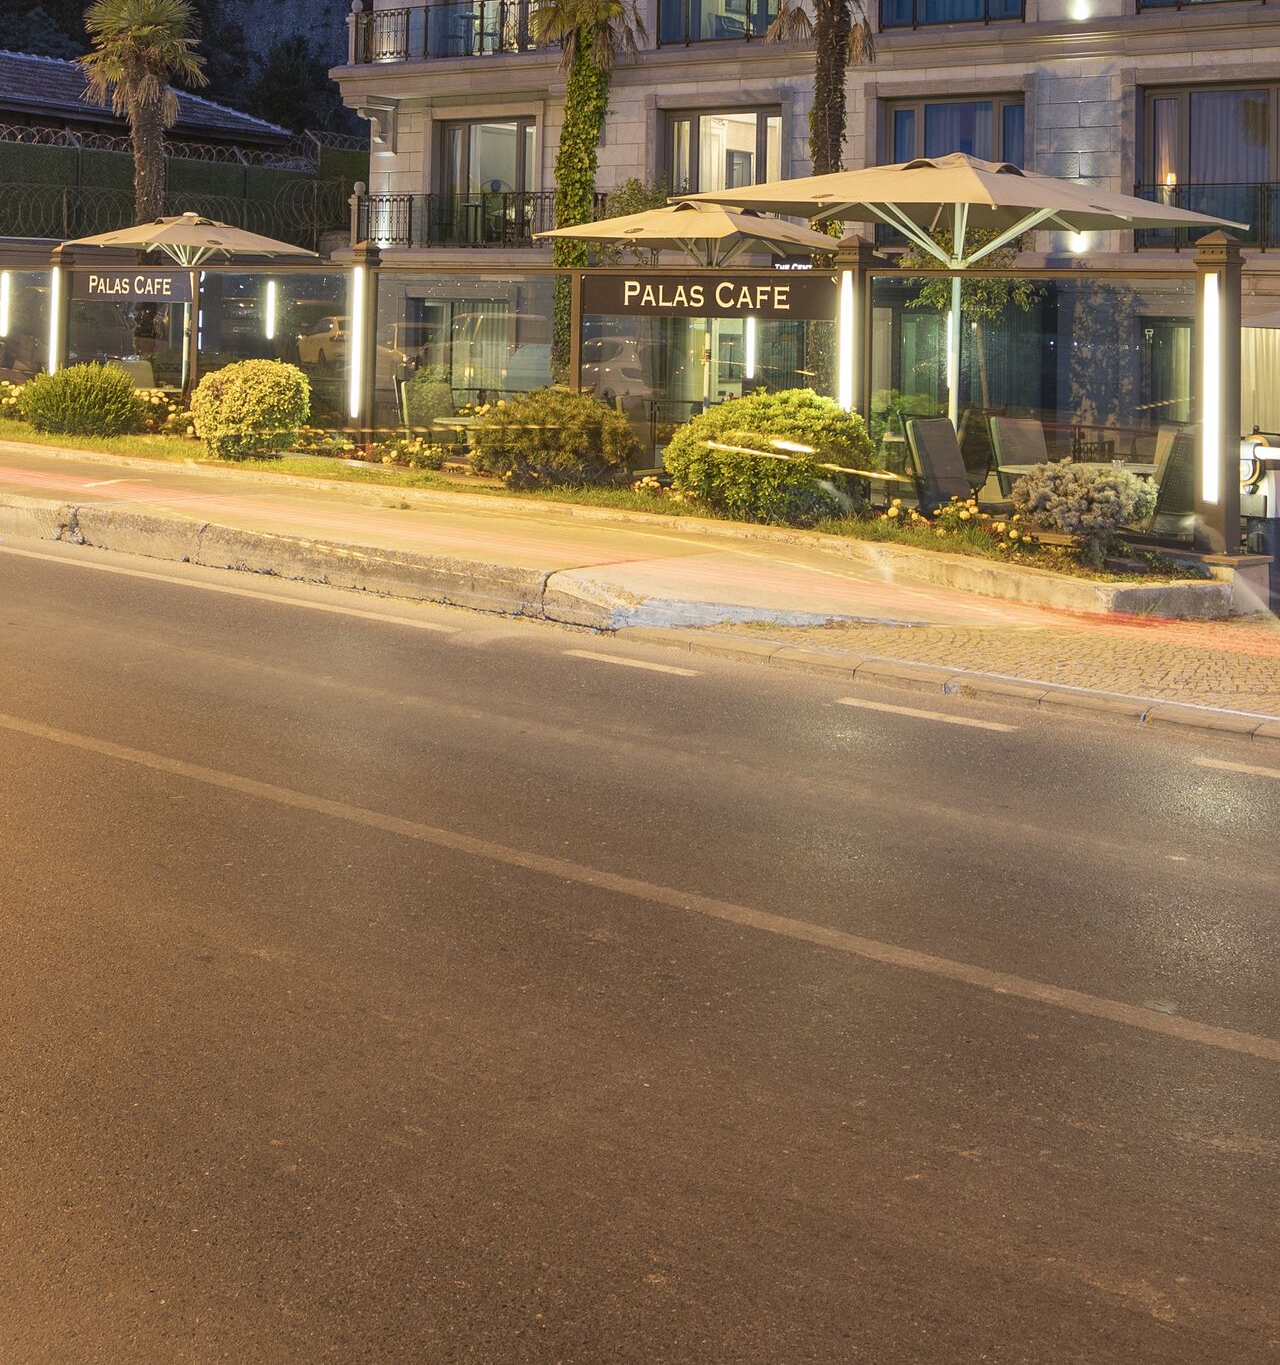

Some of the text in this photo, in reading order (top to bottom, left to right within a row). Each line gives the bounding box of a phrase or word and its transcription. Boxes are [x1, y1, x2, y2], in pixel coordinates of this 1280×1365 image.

[88, 275, 172, 295] PALAS CAFE
[623, 281, 790, 310] PALAS CAFE
